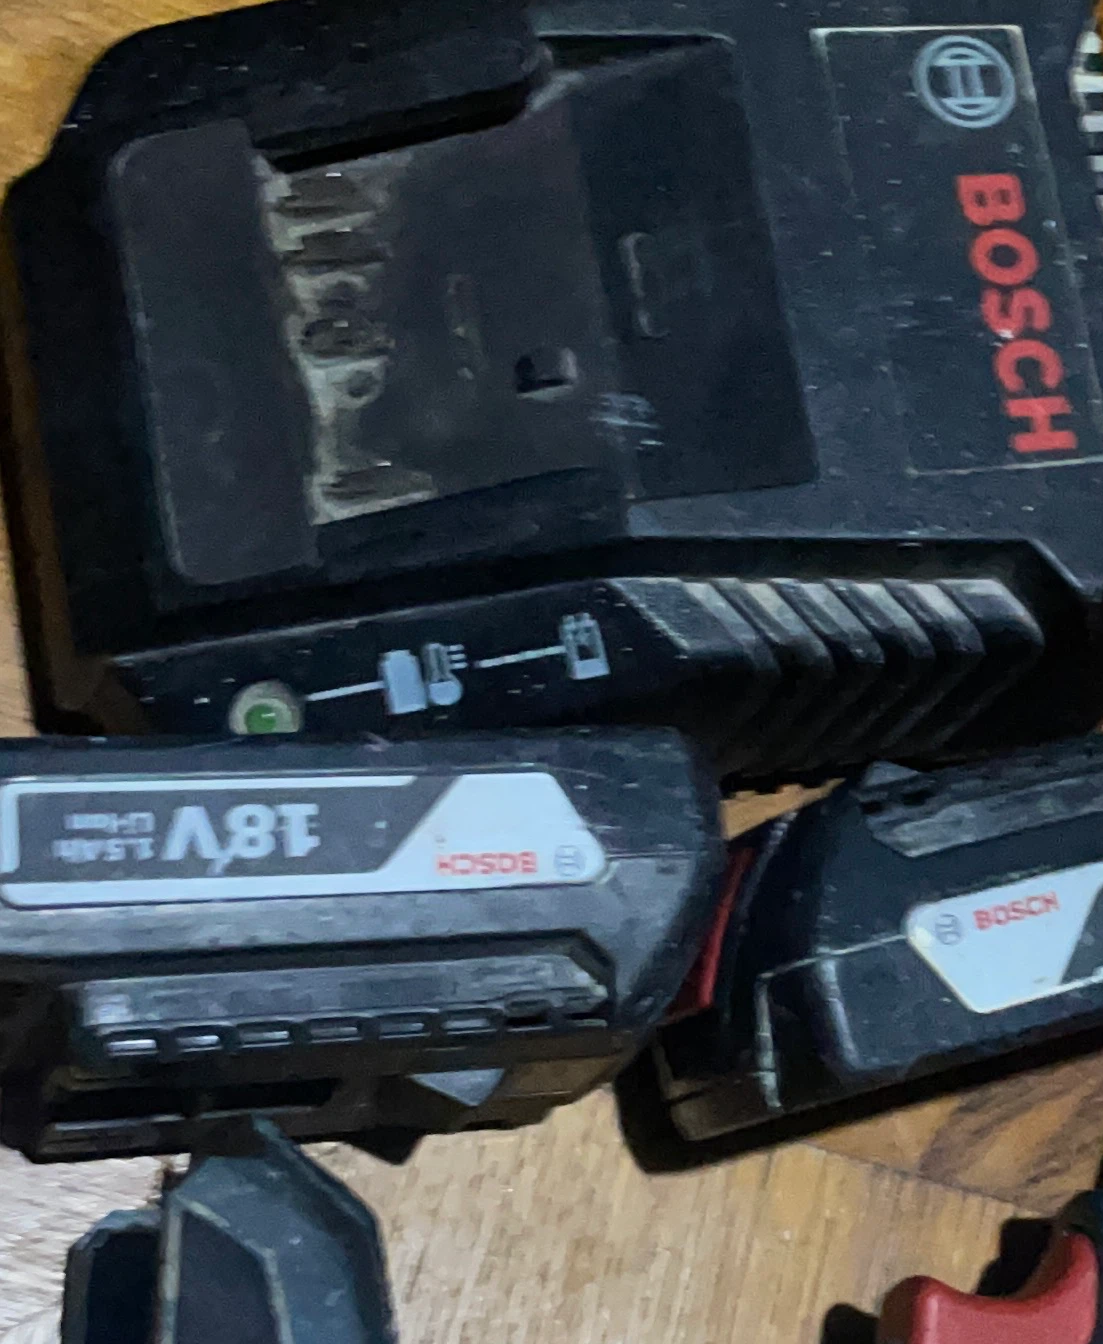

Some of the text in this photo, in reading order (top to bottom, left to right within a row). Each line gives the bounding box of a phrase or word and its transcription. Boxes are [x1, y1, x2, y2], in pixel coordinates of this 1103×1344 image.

[956, 172, 1078, 453] BOSCH
[161, 803, 539, 876] BOSCH 18V
[973, 891, 1060, 931] BOSCH
